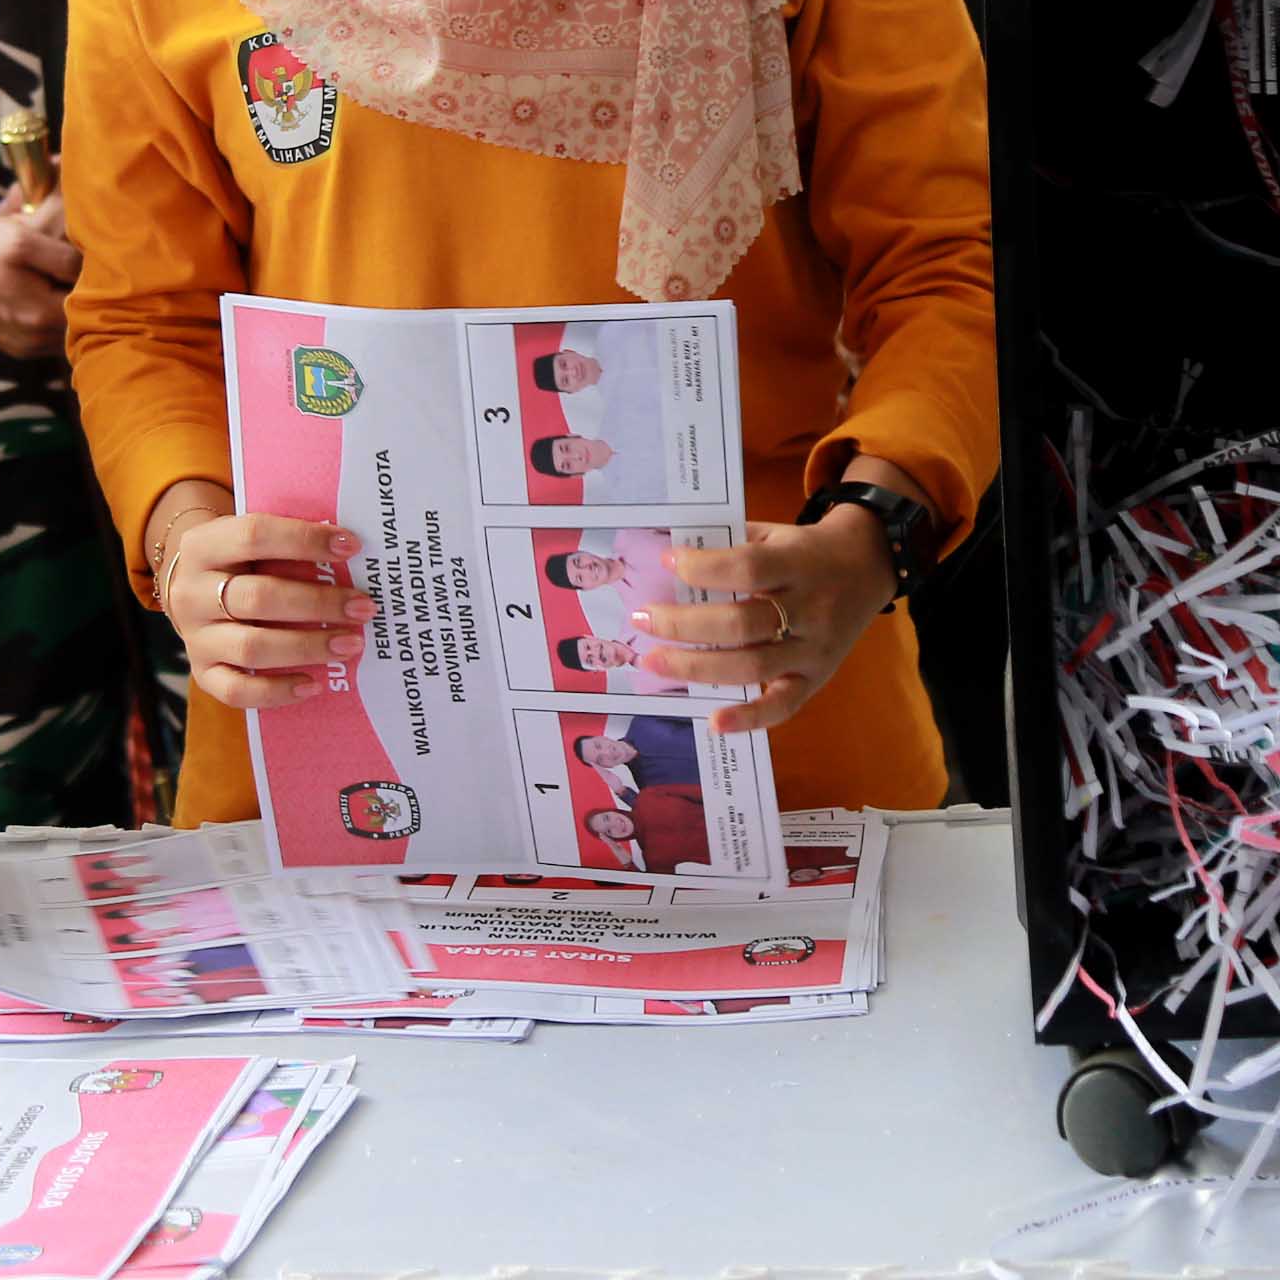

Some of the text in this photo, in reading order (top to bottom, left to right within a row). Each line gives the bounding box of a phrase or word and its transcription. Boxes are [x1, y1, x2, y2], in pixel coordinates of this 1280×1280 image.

[319, 83, 337, 148] UMUM
[484, 405, 511, 424] 3
[366, 557, 393, 660] PEMILIHAN
[376, 449, 431, 756] WALIKOTA DAN WAKIL WALIKOTA
[407, 540, 440, 677] KOTA MADIUN
[425, 510, 466, 703] PROVINSI JAWA TIMUR
[451, 556, 481, 663] TAHUN 2024
[506, 602, 533, 620] 2
[534, 780, 559, 794] 1
[340, 794, 353, 829] KOMISI
[551, 891, 569, 900] 2
[511, 913, 562, 922] JAWA
[547, 908, 614, 916] TAHUN
[570, 916, 660, 924] PROVINSI
[474, 919, 562, 928] MADIUN
[492, 927, 553, 935] WAKIL
[488, 933, 600, 943] PEMILIHAN
[560, 929, 605, 937] DAN
[613, 931, 717, 939] WALIKOTA
[445, 946, 633, 963] SURAT SUARA
[70, 1131, 109, 1165] SURAT
[37, 1166, 84, 1210] SUARA
